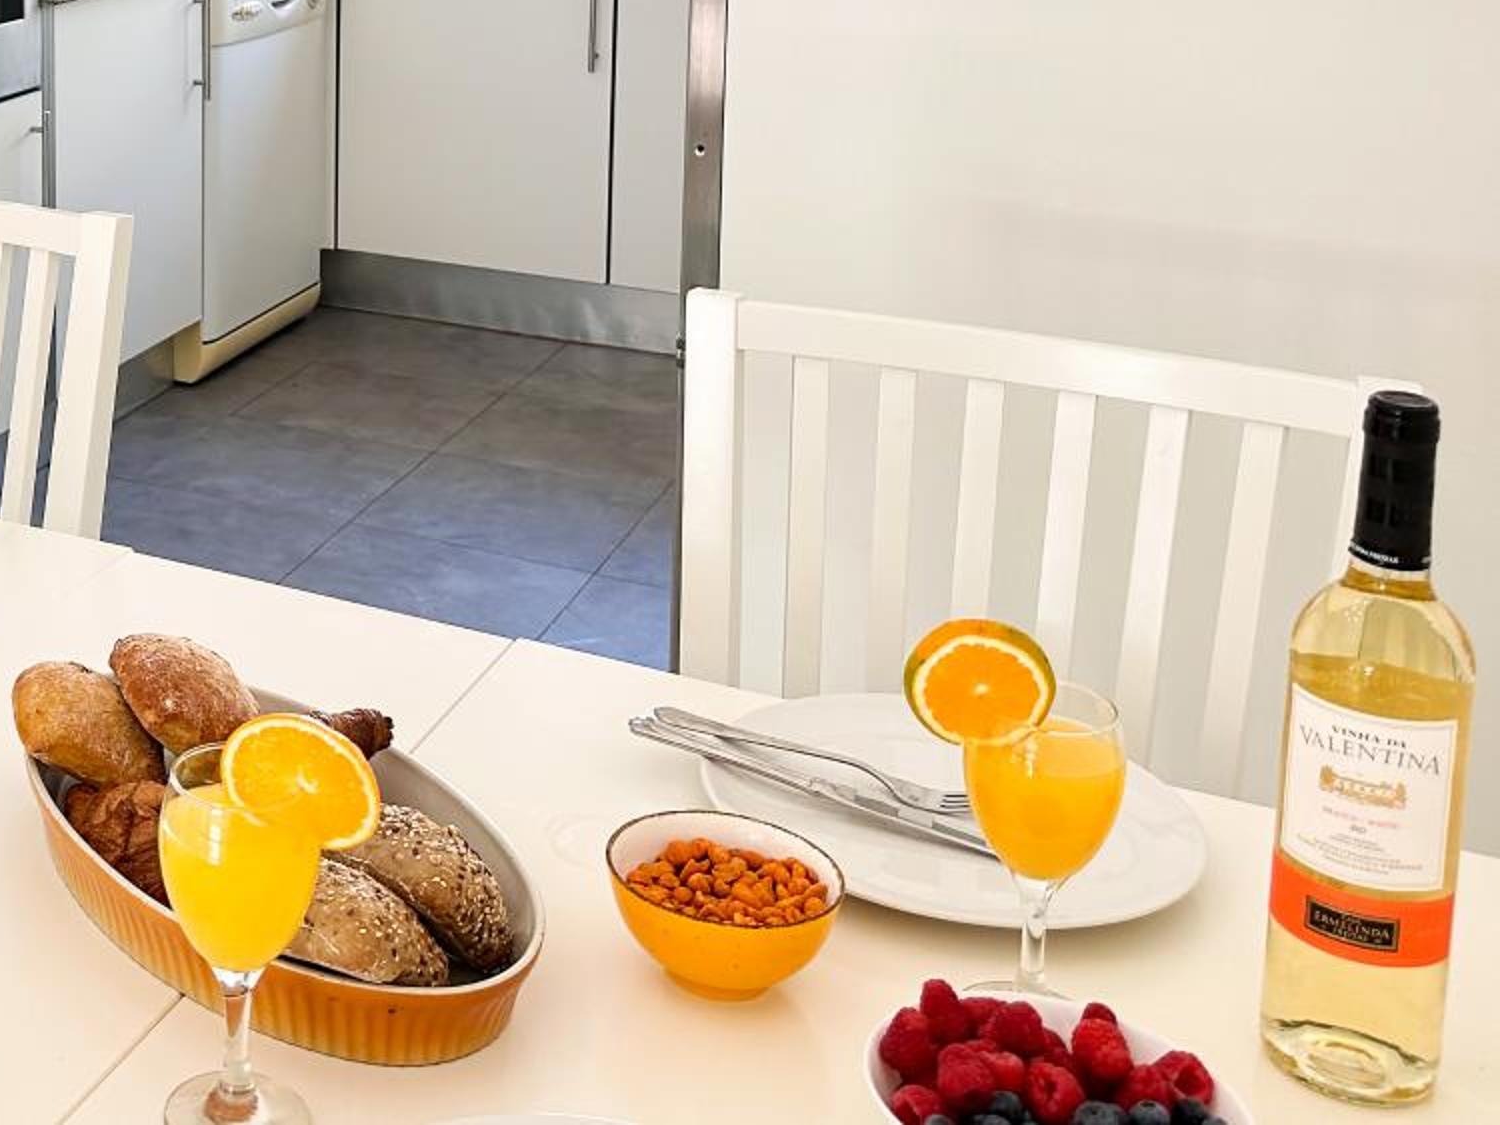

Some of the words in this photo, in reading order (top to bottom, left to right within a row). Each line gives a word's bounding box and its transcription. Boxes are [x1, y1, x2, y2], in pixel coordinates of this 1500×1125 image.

[1300, 725, 1441, 776] VALENTINA
[1332, 725, 1381, 744] VINHA
[1387, 738, 1407, 748] DA
